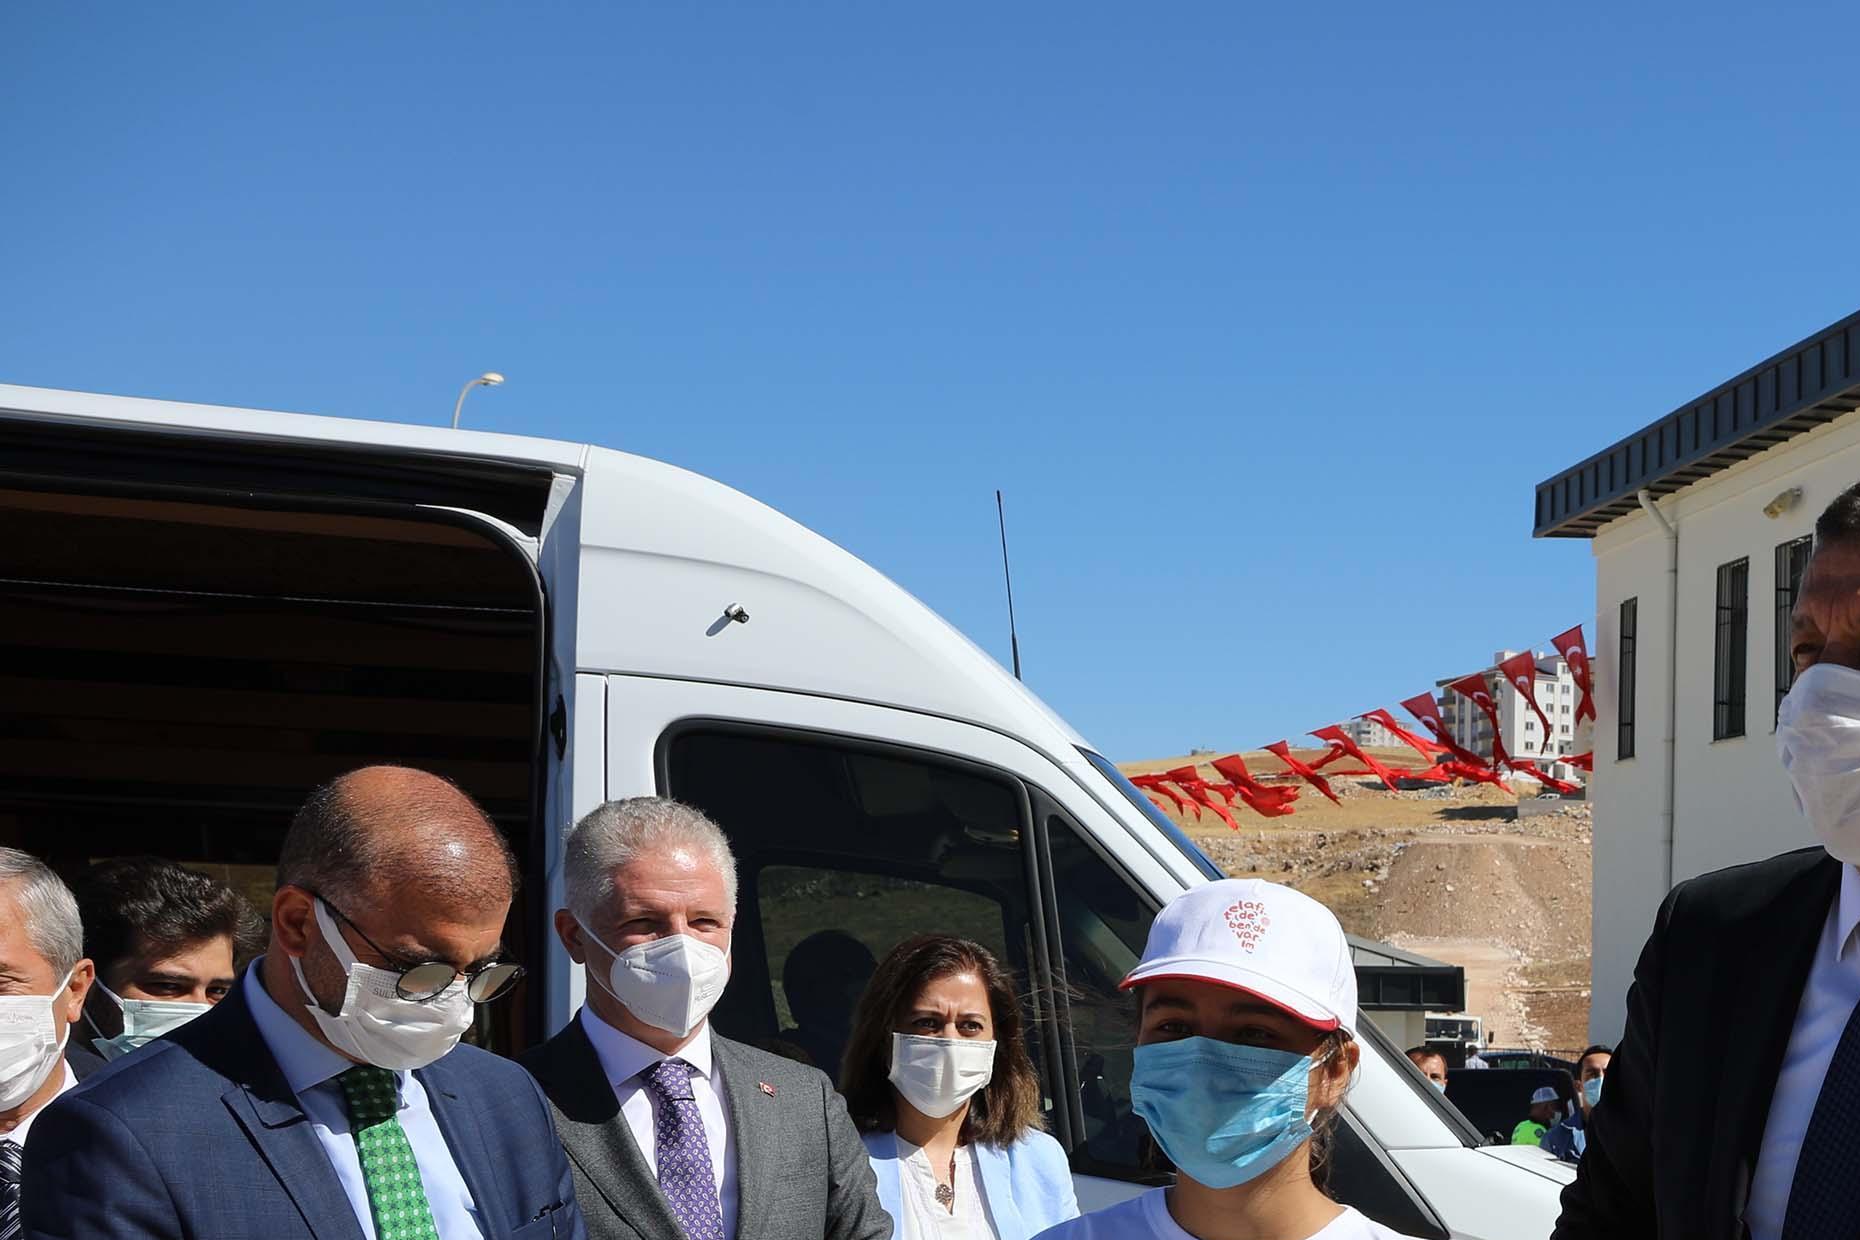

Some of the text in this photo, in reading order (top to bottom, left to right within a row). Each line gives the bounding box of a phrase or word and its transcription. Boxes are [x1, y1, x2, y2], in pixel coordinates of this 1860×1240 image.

[1239, 910, 1255, 920] de
[1229, 920, 1251, 930] ben
[1236, 931, 1259, 941] var
